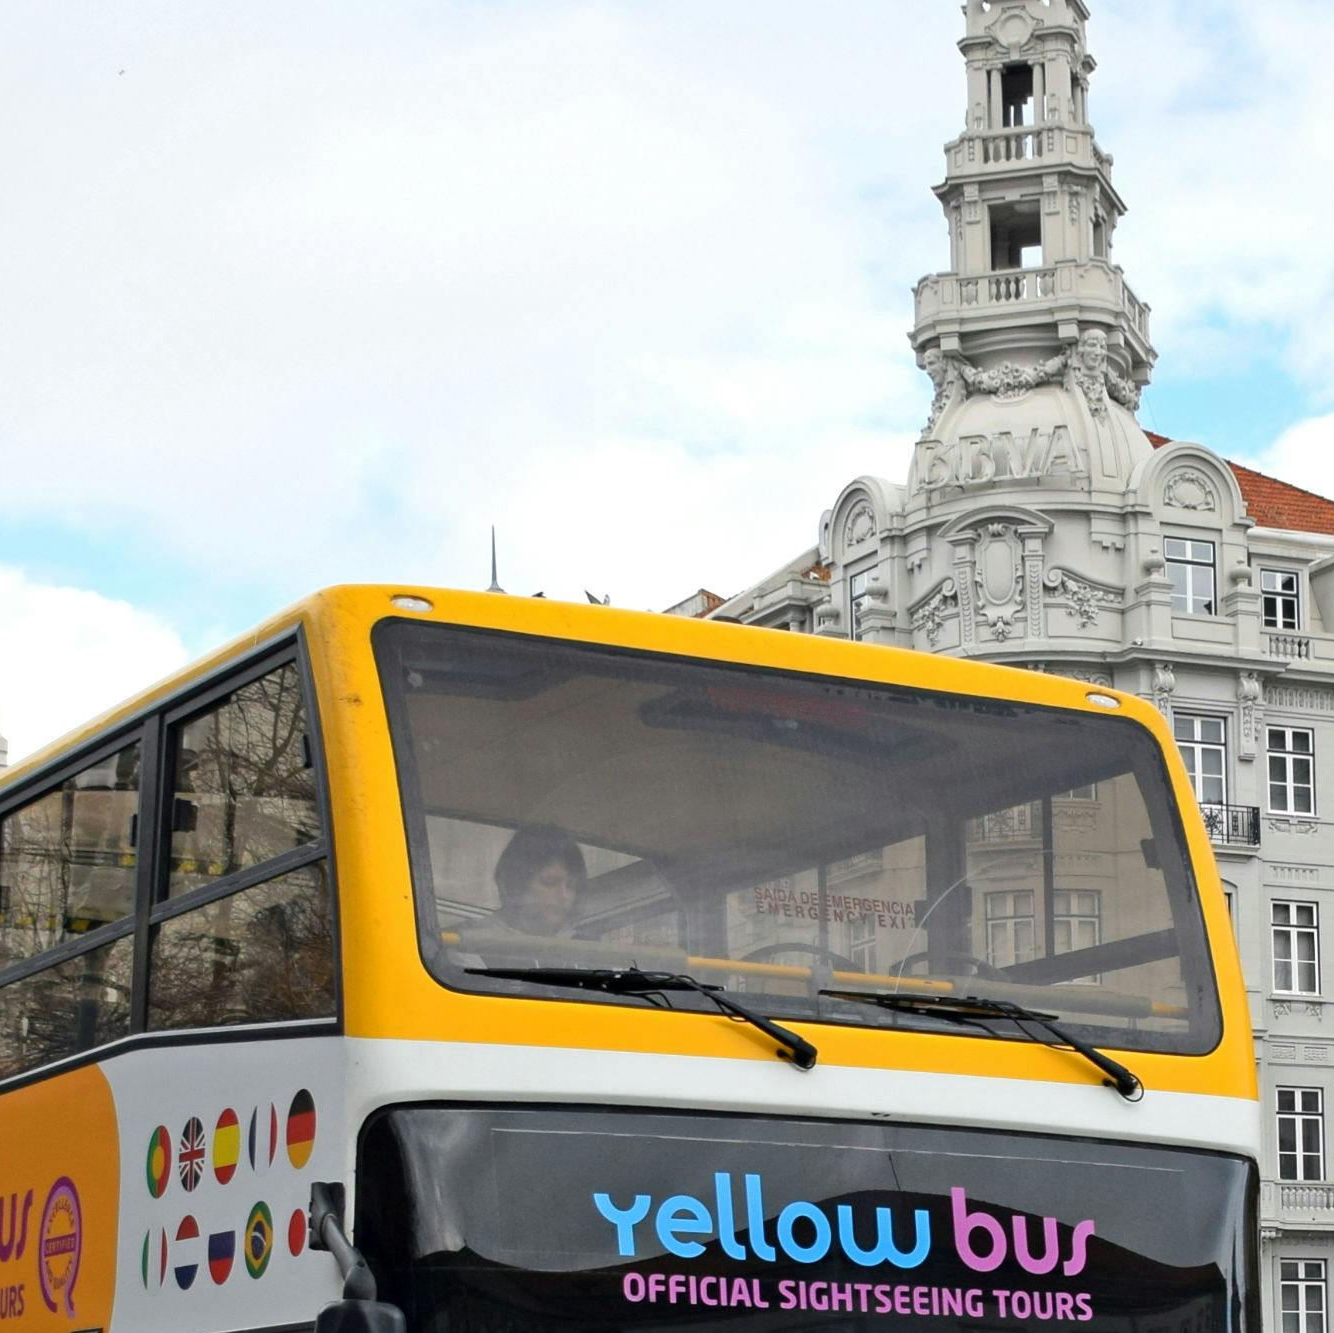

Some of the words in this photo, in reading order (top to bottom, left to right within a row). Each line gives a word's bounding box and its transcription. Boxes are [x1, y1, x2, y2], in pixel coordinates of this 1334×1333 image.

[800, 891, 818, 905] DE
[950, 1187, 1095, 1276] bus
[623, 1272, 769, 1308] OFFICIAL
[779, 1280, 983, 1318] SIGHTSEEING
[992, 1290, 1094, 1321] TOURS
